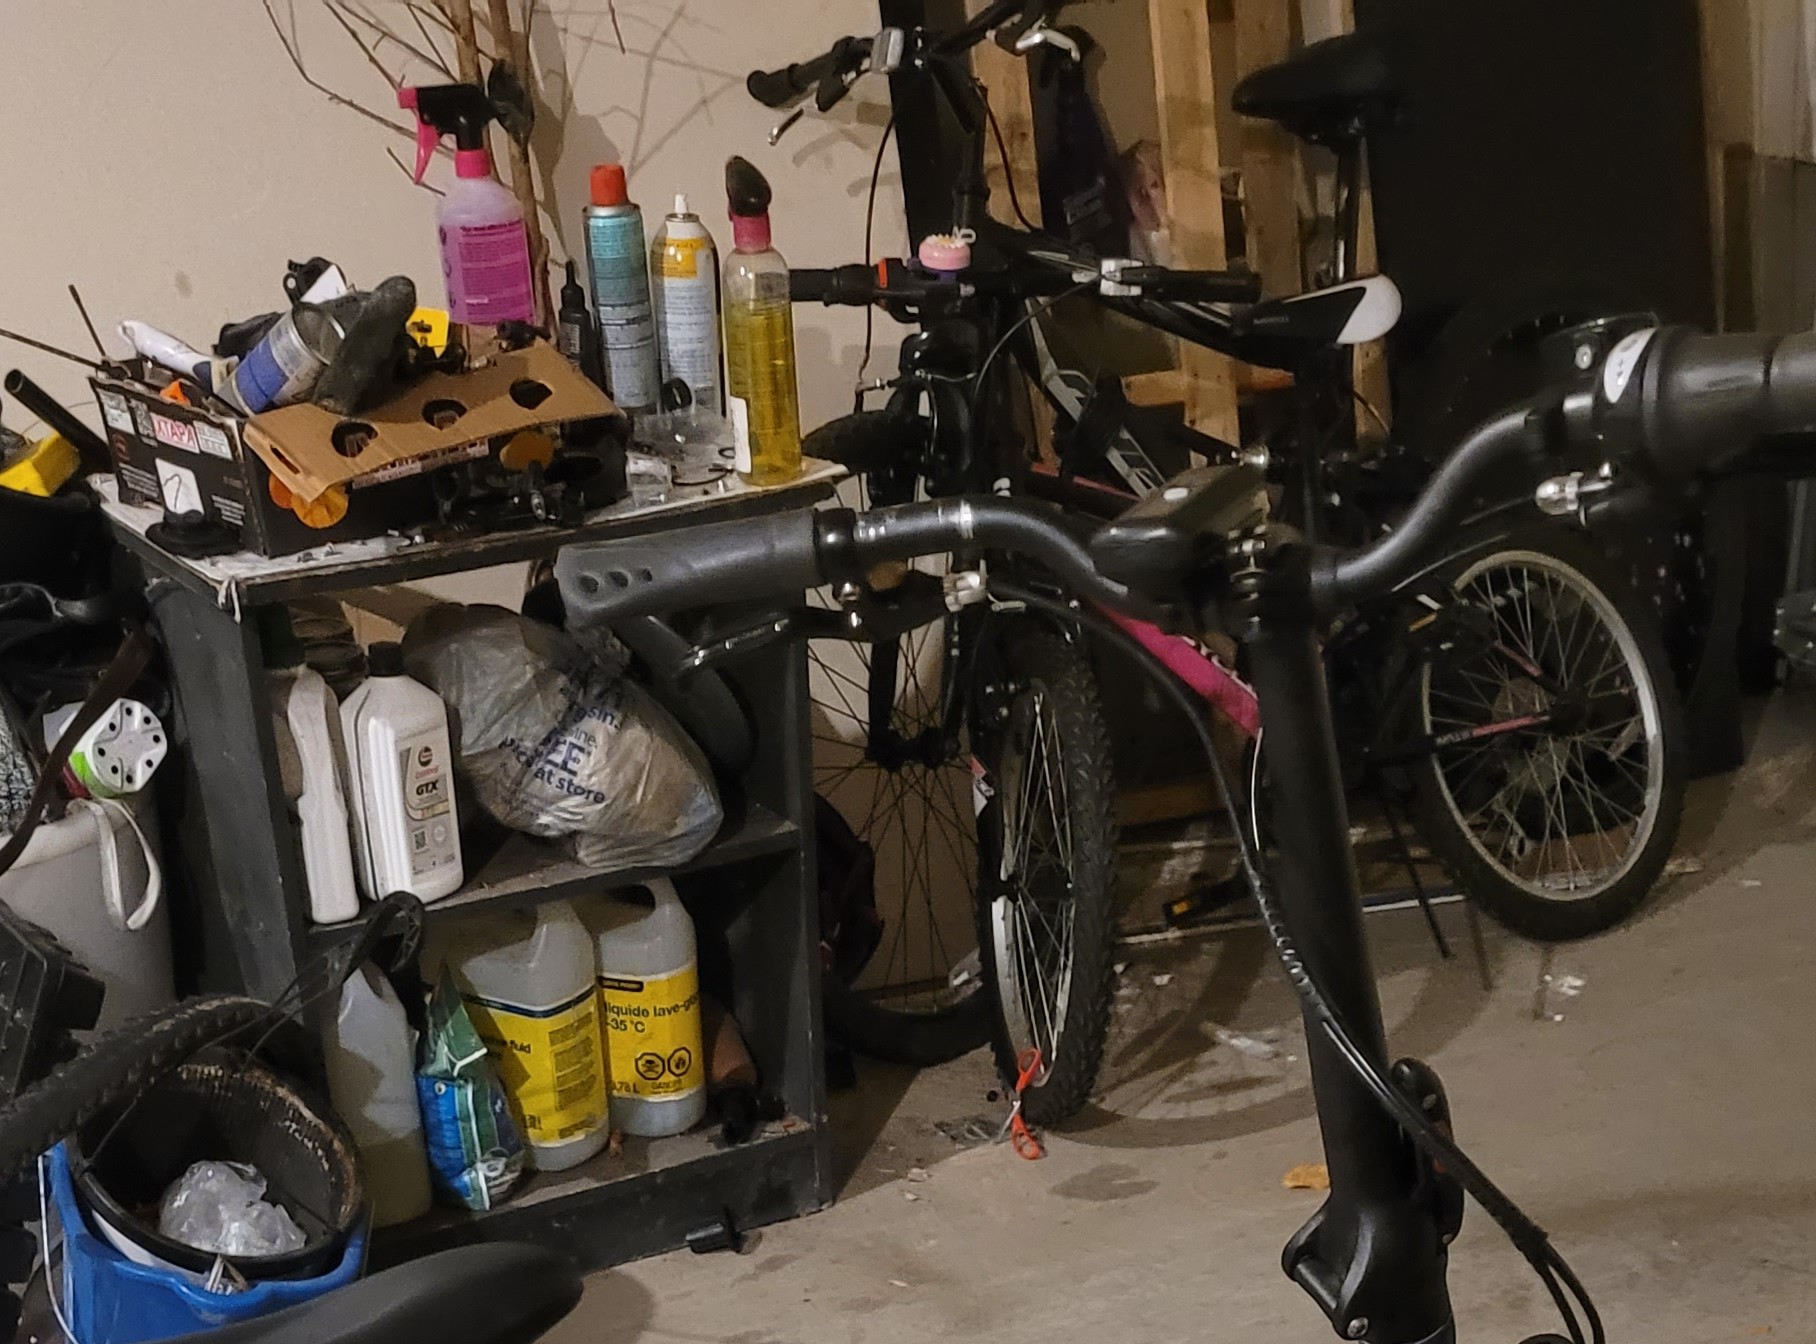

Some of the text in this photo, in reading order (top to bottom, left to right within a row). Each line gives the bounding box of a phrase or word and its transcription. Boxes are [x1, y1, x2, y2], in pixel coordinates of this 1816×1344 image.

[416, 780, 438, 796] GTX
[556, 777, 605, 804] store
[604, 1001, 650, 1018] liquide
